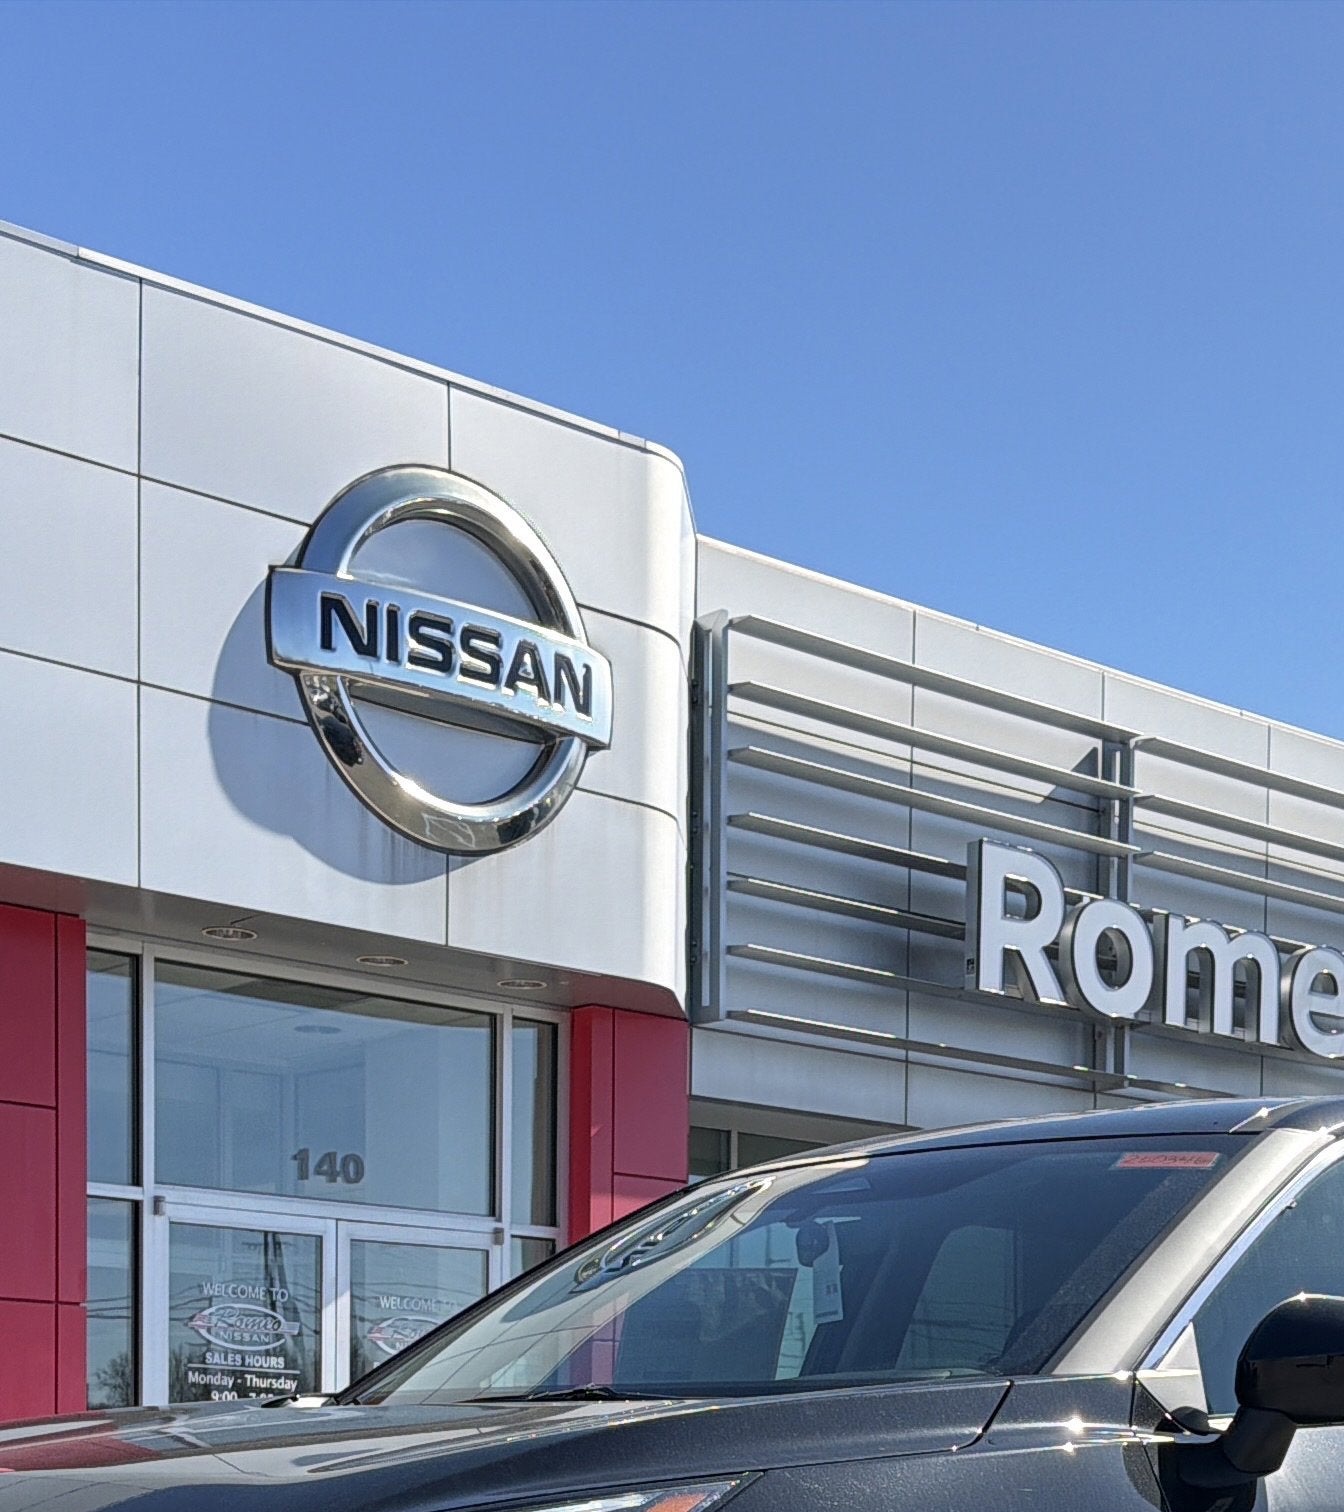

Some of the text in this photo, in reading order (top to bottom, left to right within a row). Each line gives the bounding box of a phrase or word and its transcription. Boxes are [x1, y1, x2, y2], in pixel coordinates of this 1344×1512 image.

[320, 592, 593, 723] NISSAN
[291, 1147, 365, 1185] 140
[202, 1282, 289, 1302] WELCOME TO
[380, 1296, 438, 1313] WELCOME
[209, 1306, 282, 1332] Romeo
[219, 1330, 271, 1344] NISSAN
[205, 1352, 286, 1369] SALES HOURS
[187, 1370, 234, 1389] Monday
[244, 1374, 298, 1391] Thursday
